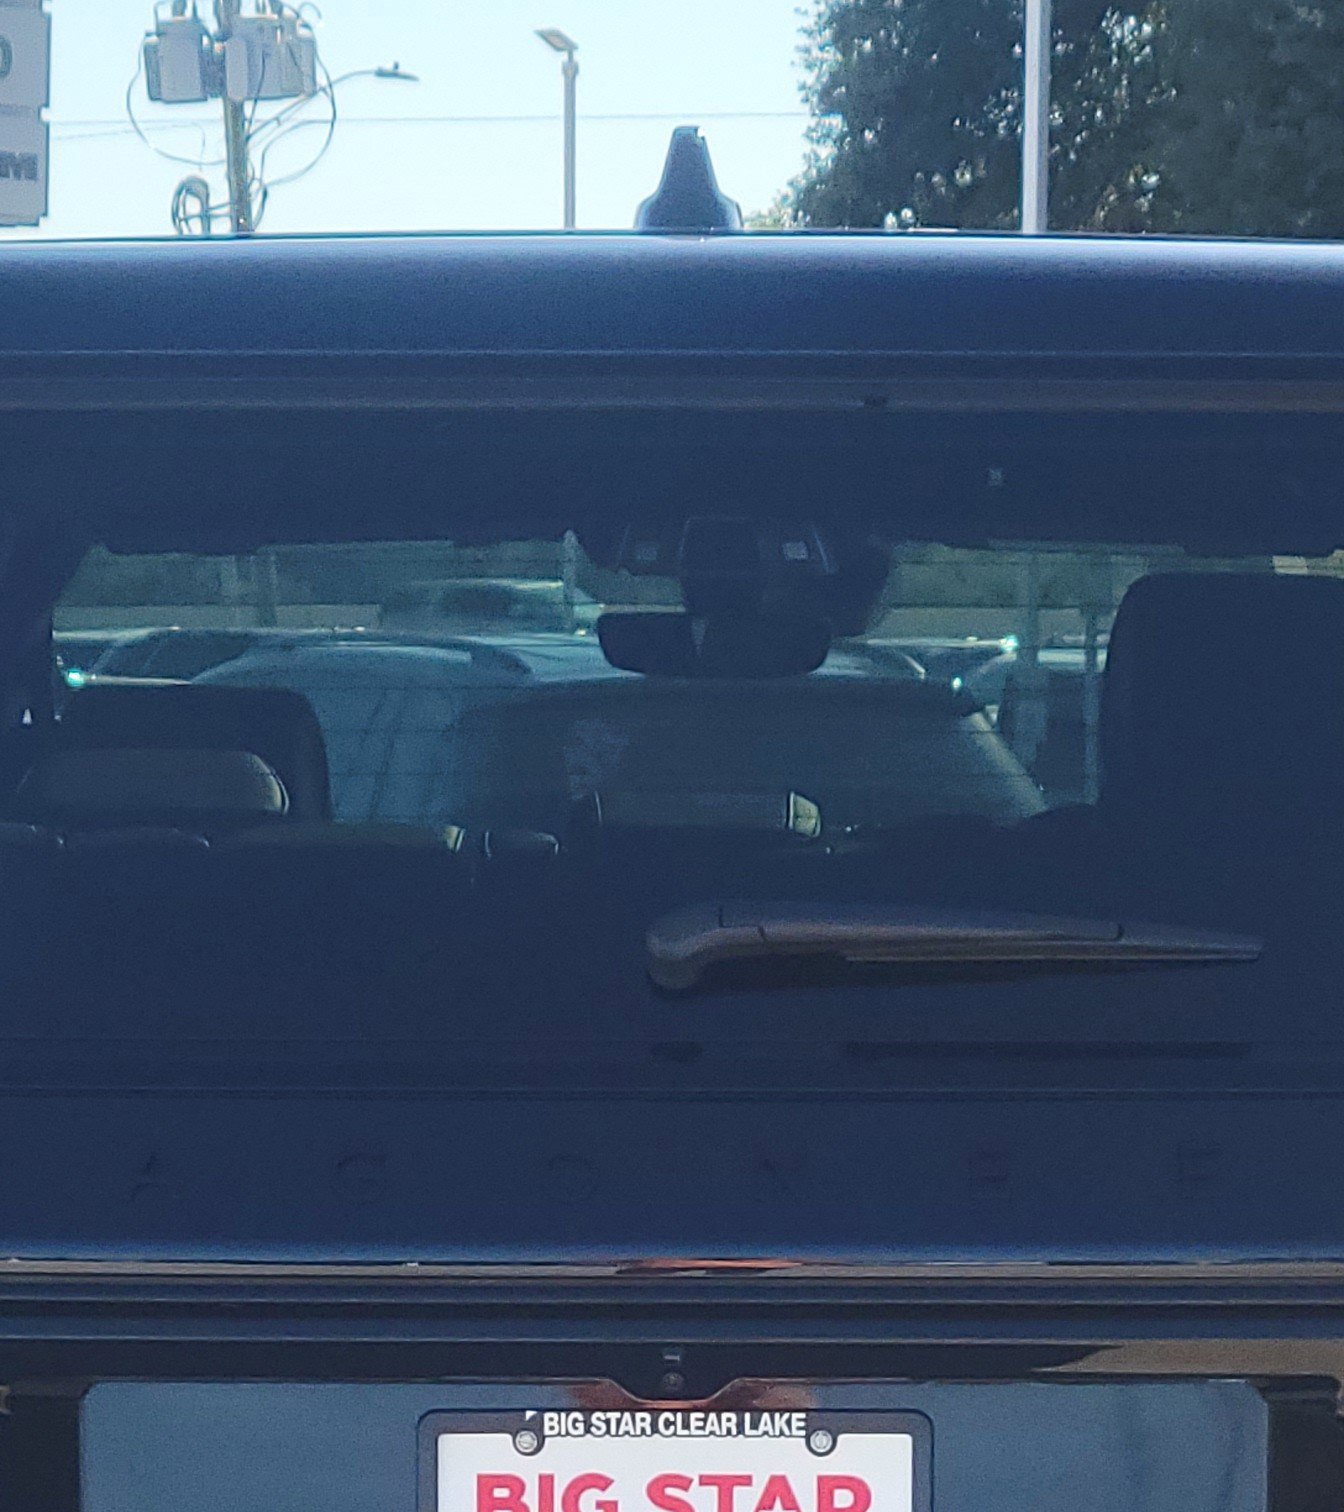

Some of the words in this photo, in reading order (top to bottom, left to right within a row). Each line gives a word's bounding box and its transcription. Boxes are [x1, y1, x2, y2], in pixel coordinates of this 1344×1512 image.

[543, 1412, 584, 1436] BIG
[590, 1412, 652, 1436] STAR
[658, 1412, 737, 1436] CLEAR
[744, 1412, 806, 1436] LAKE
